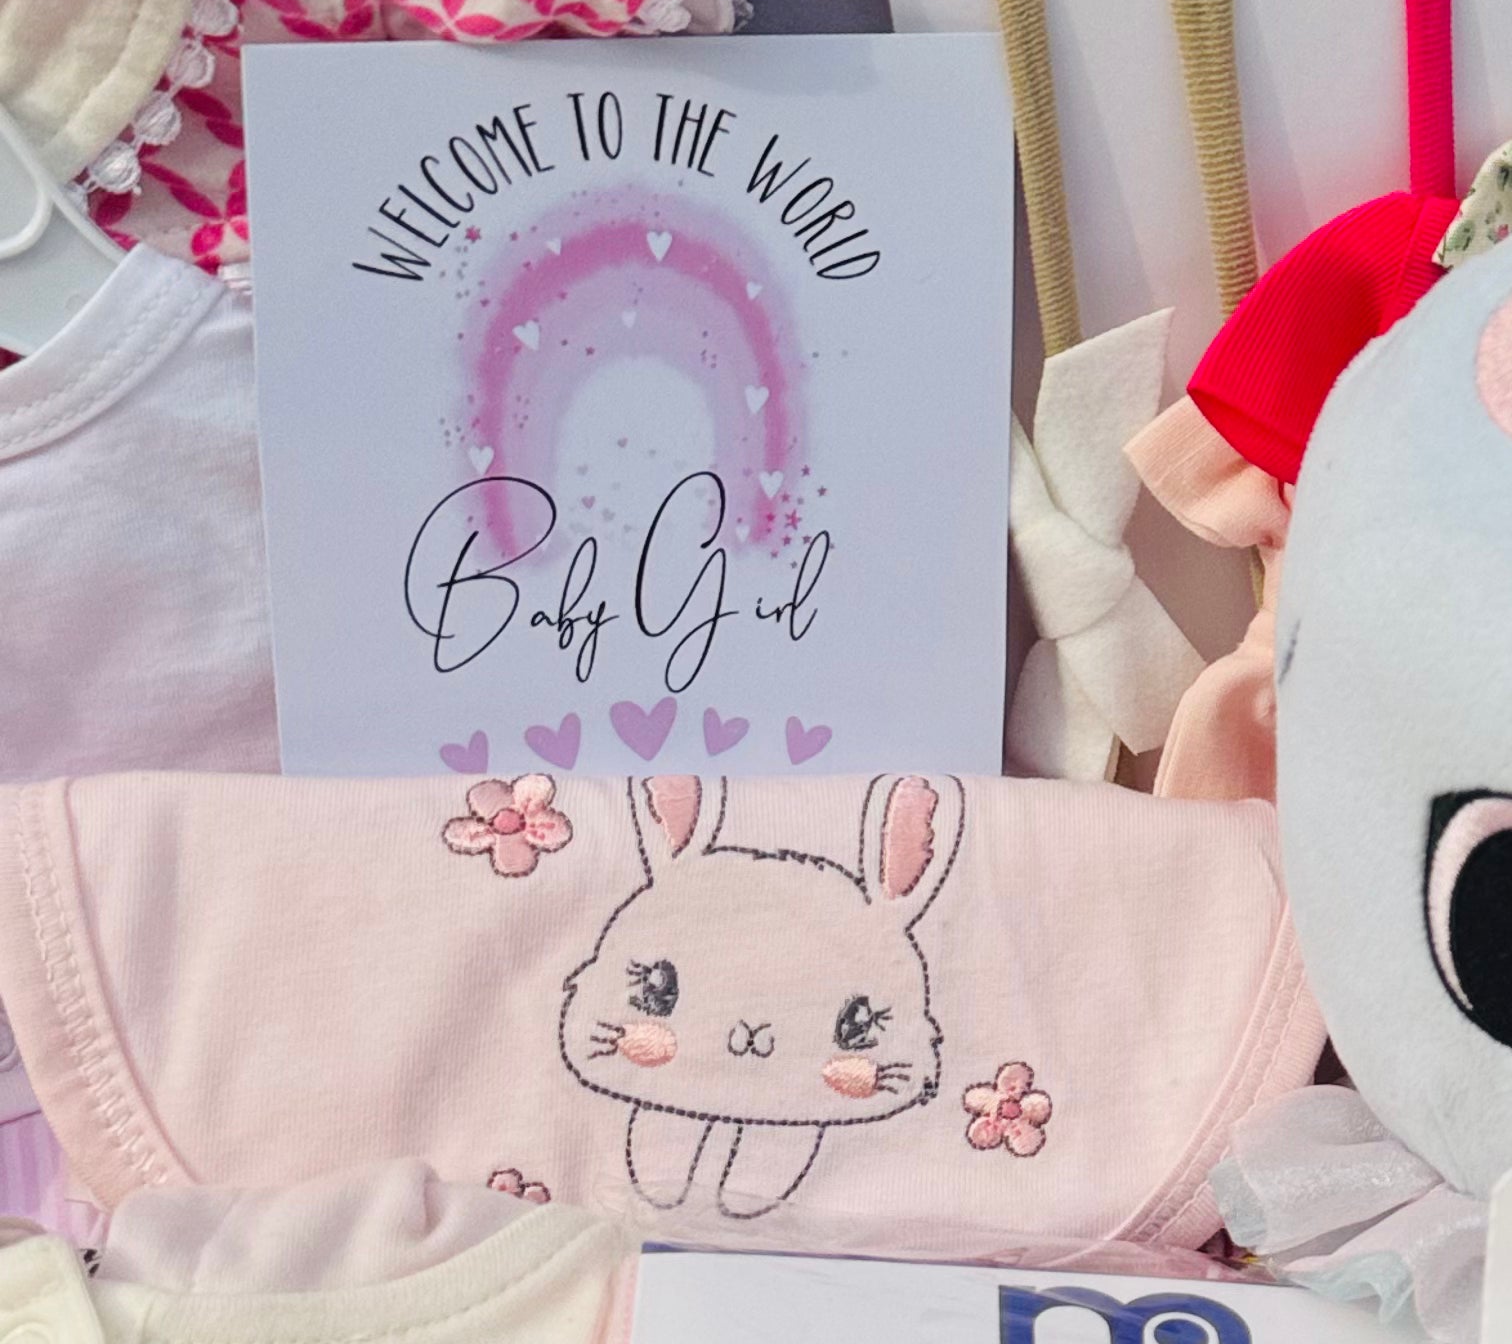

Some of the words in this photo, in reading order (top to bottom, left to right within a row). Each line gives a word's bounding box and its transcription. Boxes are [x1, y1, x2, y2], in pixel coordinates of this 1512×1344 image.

[352, 102, 555, 285] WELCOME
[567, 91, 624, 161] TO
[652, 93, 738, 178] THE
[746, 133, 883, 282] WORLD
[404, 475, 621, 684] Baby
[633, 470, 832, 694] Girl
